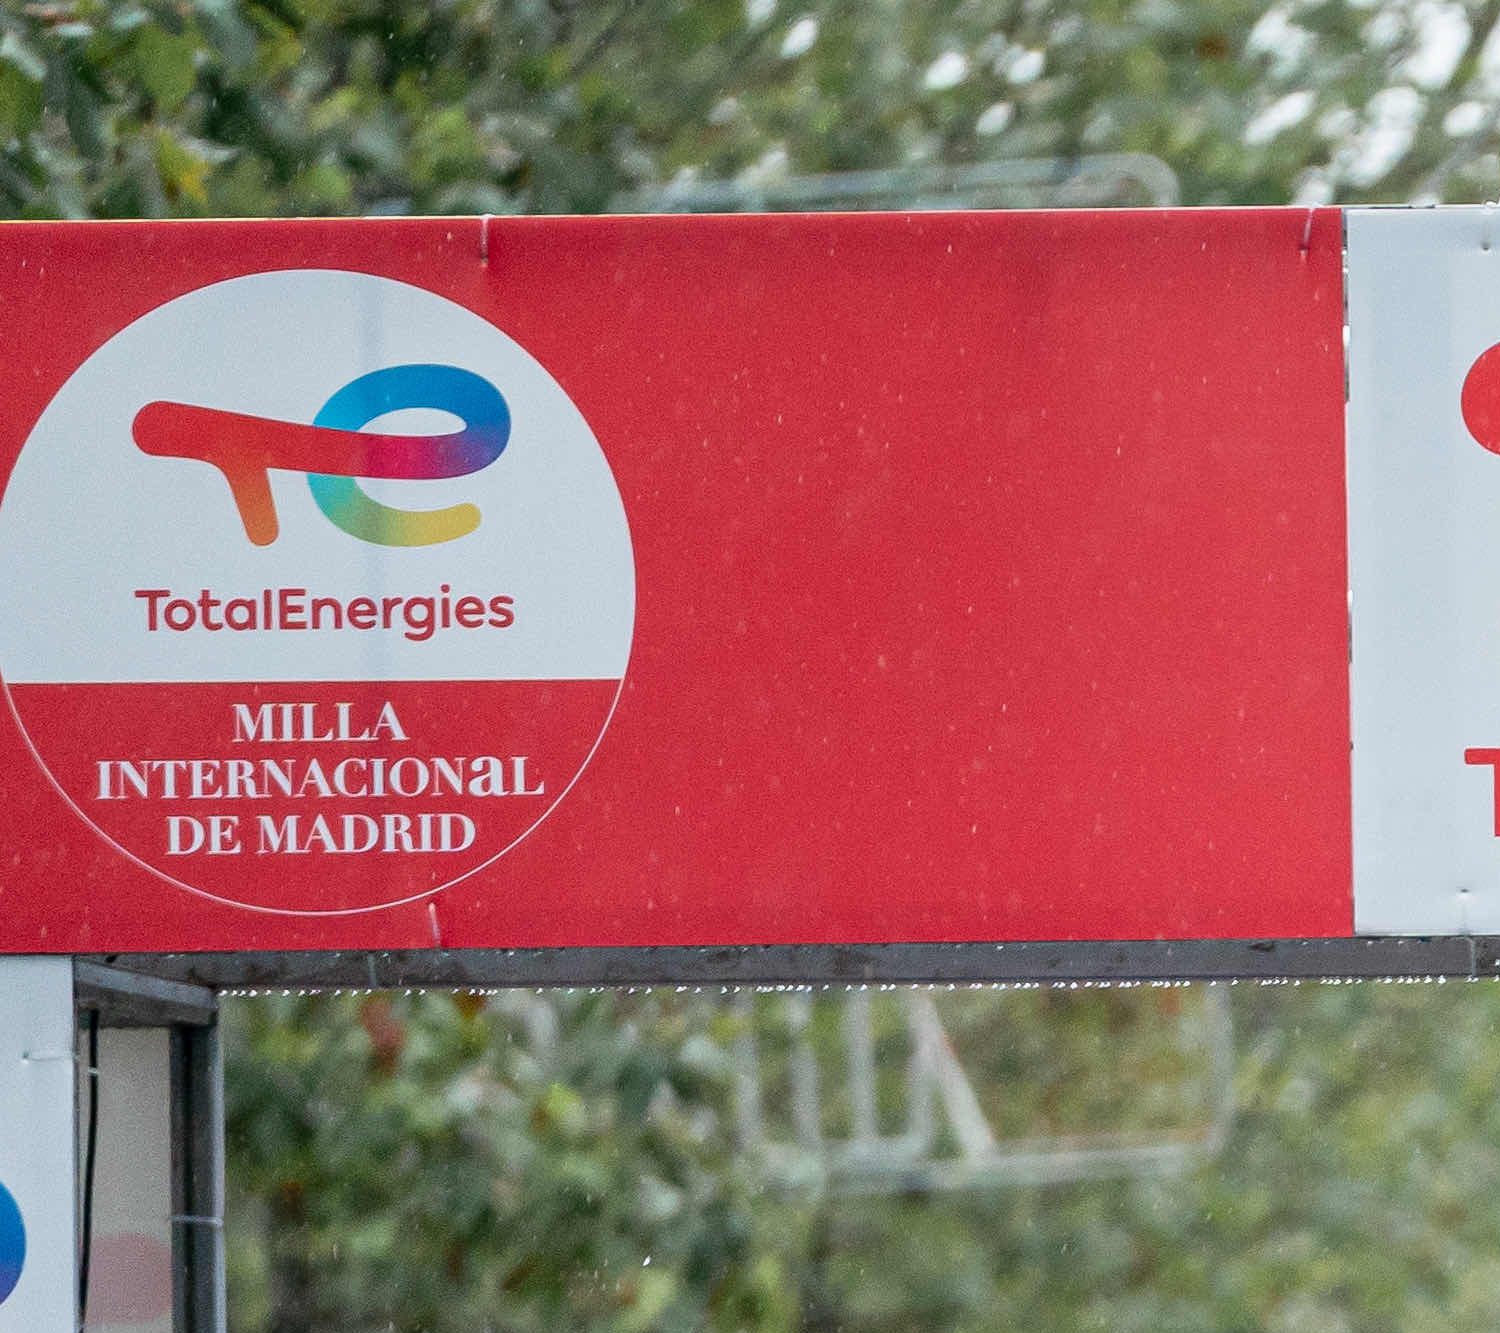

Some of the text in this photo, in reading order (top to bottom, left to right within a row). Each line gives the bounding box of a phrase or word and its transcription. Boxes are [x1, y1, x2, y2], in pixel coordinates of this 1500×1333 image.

[135, 583, 515, 641] TotalEnergies
[231, 701, 410, 743] MILLA
[166, 813, 476, 856] DE MADRID
